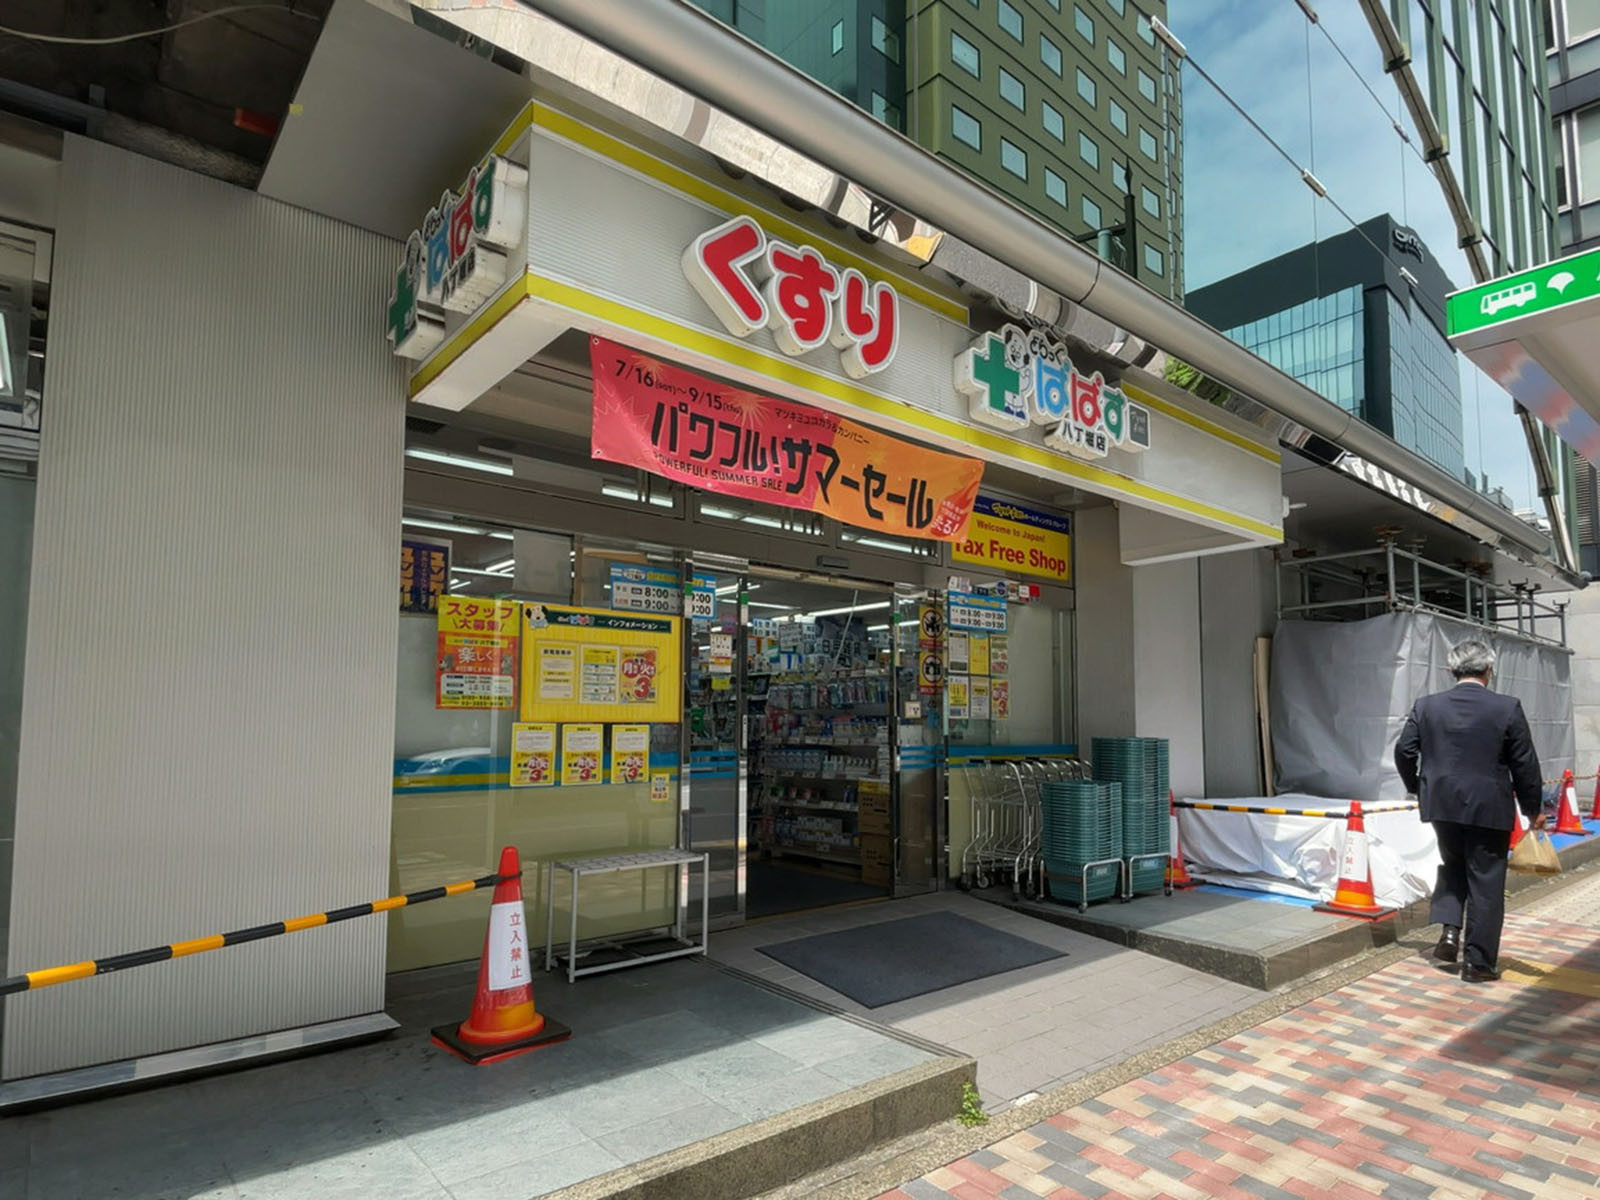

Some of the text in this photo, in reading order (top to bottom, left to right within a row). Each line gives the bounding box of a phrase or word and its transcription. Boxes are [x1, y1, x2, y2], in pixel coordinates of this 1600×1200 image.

[702, 224, 894, 366] くすり
[1035, 356, 1127, 440] ぱぱす
[1061, 424, 1106, 452] 八丁堀店
[711, 469, 758, 486] SUMMER
[761, 477, 783, 492] SALE
[976, 520, 1046, 543] Welcome to Japan!
[990, 540, 1025, 565] Free
[1029, 549, 1066, 576] Shop
[644, 587, 669, 600] 8:00
[447, 602, 513, 619] スタッフ
[644, 599, 669, 612] 9:00
[458, 618, 499, 632] 大募集
[607, 619, 659, 630] インフォメーション
[457, 647, 495, 664] 楽しく
[509, 912, 522, 980] 立入禁止
